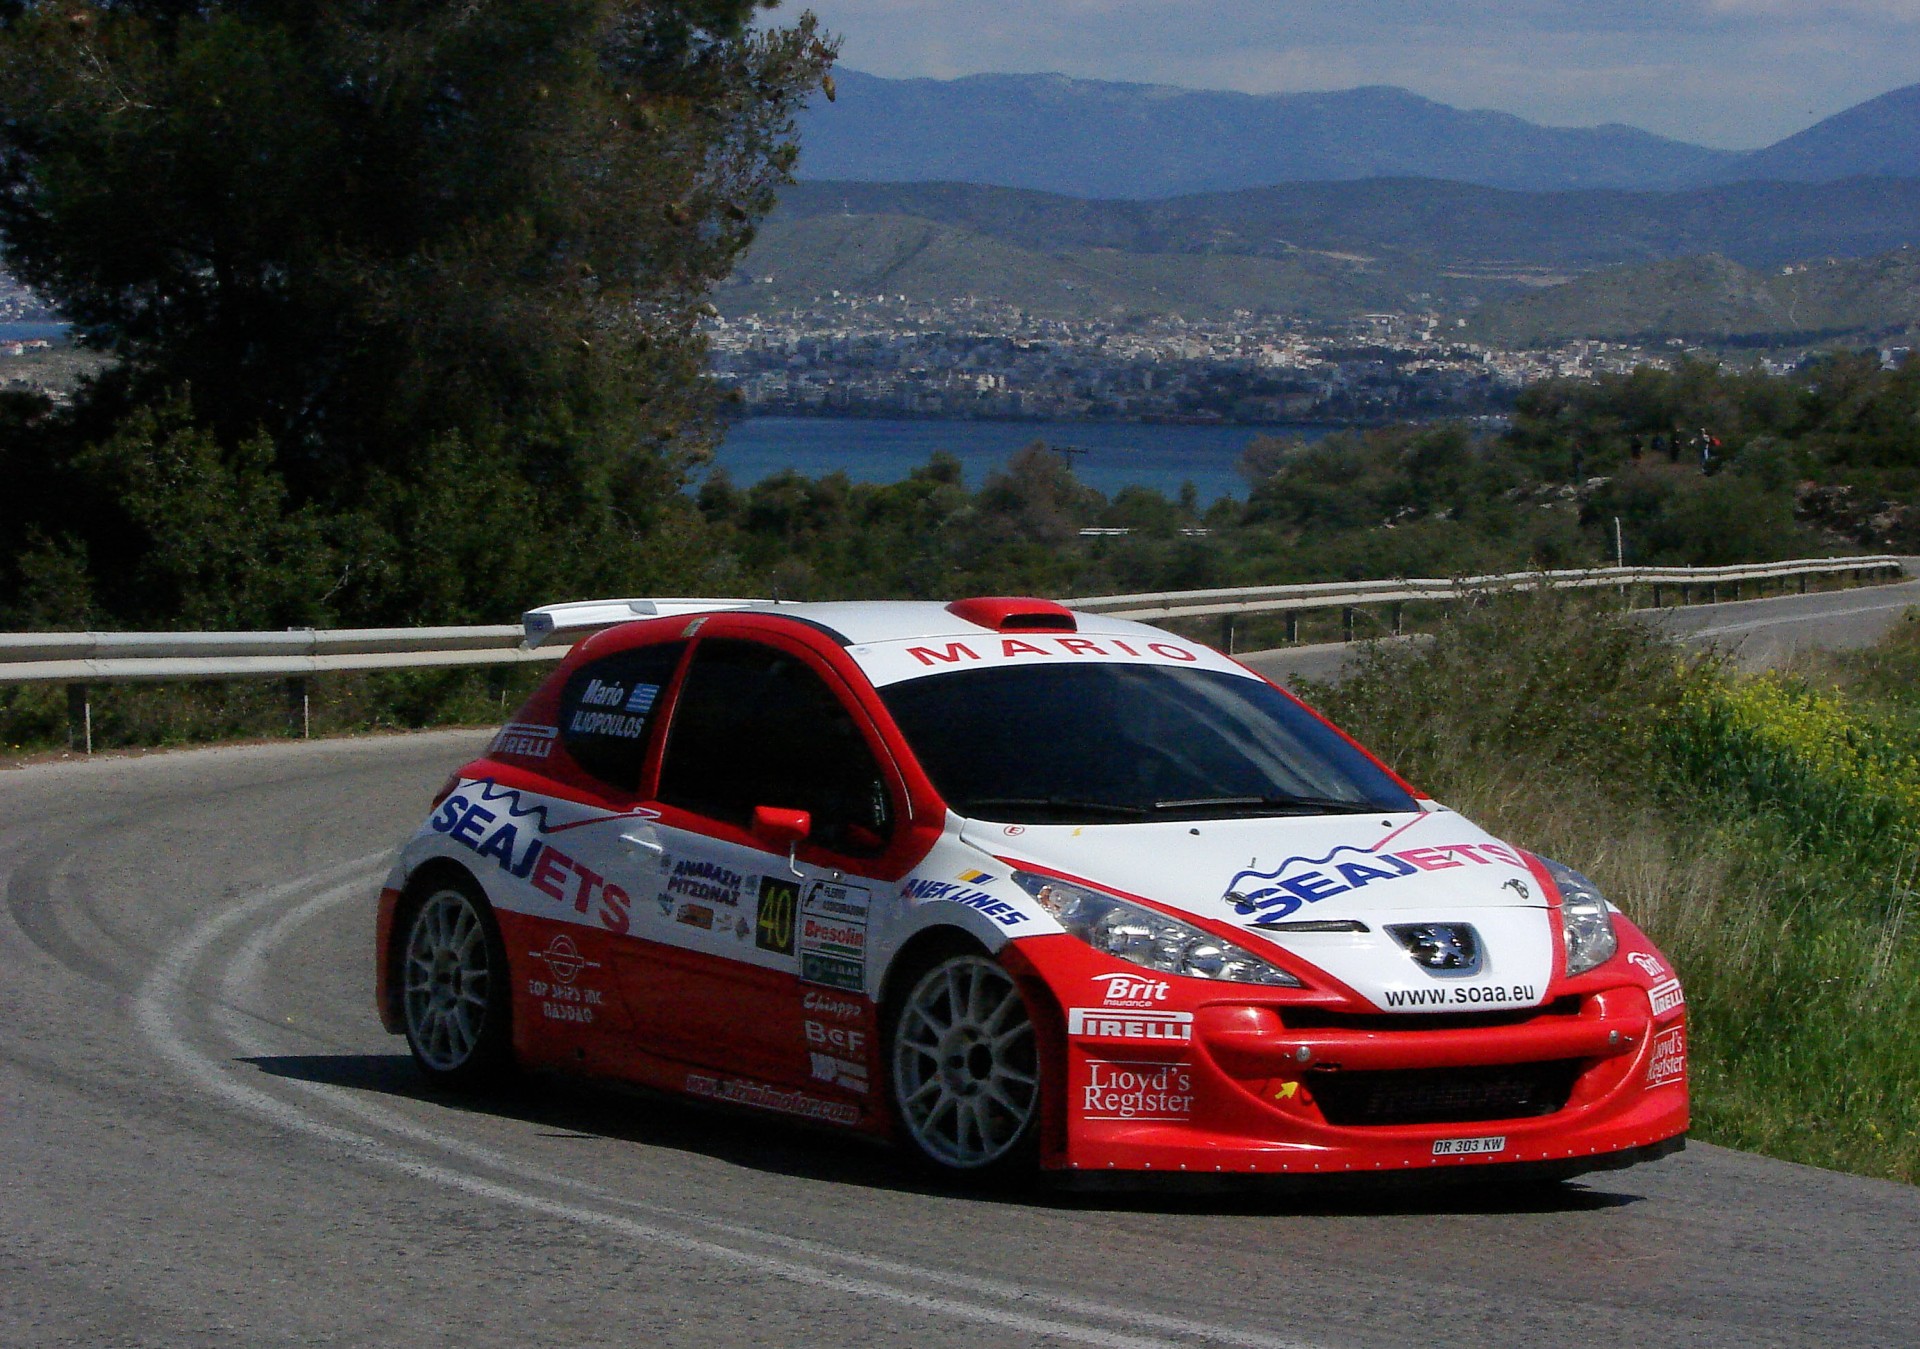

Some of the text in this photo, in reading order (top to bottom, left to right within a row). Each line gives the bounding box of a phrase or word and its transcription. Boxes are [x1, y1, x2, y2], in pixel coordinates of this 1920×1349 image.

[906, 638, 1198, 666] MARIO
[582, 679, 624, 707] Mario
[491, 722, 559, 758] PIRELLI
[570, 710, 646, 739] ILIOPOULOS
[432, 795, 631, 934] SEAJETS
[1234, 843, 1530, 924] SEAJETS
[759, 886, 791, 948] 40
[947, 888, 1031, 926] LINES
[1105, 977, 1171, 1001] Brit
[1384, 984, 1534, 1007] www.soaa.eu
[1648, 977, 1685, 1017] PIRELLI
[1068, 1007, 1194, 1040] PIRELLI
[1089, 1063, 1191, 1094] Lloyd's
[1082, 1085, 1194, 1118] Register
[1455, 1138, 1480, 1153] 303
[1482, 1137, 1504, 1151] KW
